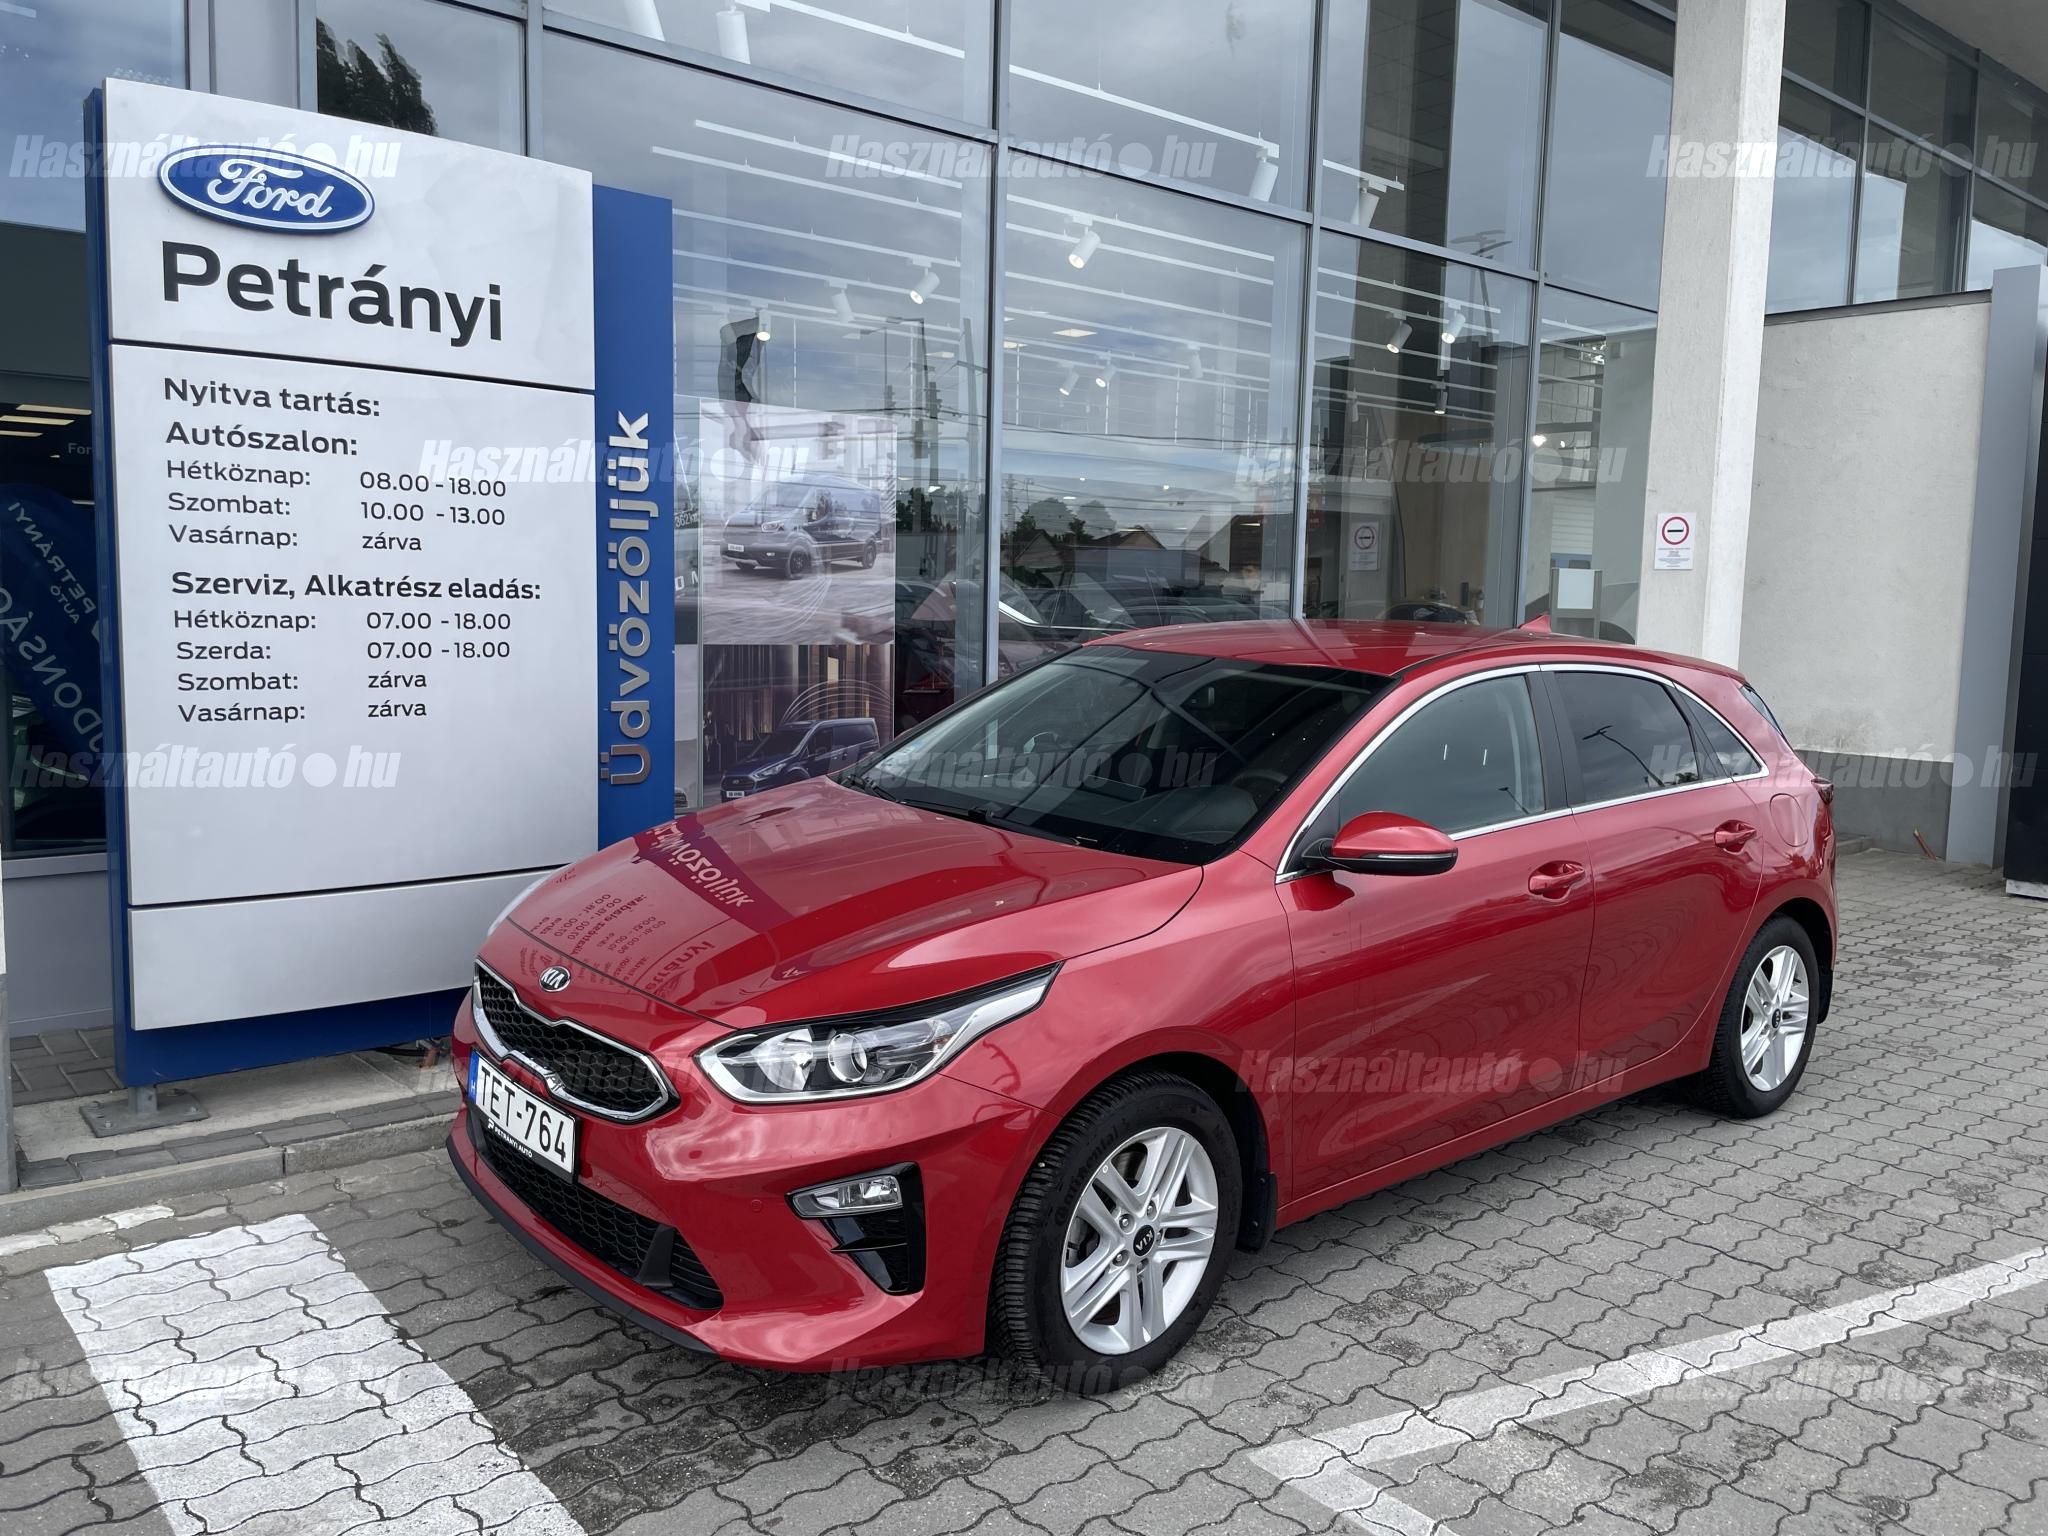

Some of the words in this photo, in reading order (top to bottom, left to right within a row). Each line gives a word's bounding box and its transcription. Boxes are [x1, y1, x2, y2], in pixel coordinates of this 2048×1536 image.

[162, 240, 502, 347] Petrányi
[165, 378, 271, 408] Nyitva
[279, 389, 379, 416] tartás:
[166, 422, 356, 455] Autószalon:
[168, 460, 310, 488] Hétköznap:
[361, 472, 429, 492] 08.00
[449, 478, 505, 497] 18.00
[169, 493, 289, 515] Szombat:
[361, 502, 423, 521] 10.00
[450, 507, 504, 525] 13.00
[169, 525, 297, 549] Vasárnap:
[363, 532, 421, 550] zárva
[172, 572, 294, 599] Szerviz,
[305, 574, 442, 597] Alkatrész
[449, 578, 540, 599] eladás:
[600, 411, 659, 787] Üdvözöljük
[175, 610, 315, 632] Hétköznap:
[367, 612, 431, 629] 07.00
[455, 613, 510, 629] 18.00
[177, 641, 270, 659] Szerda:
[368, 642, 431, 658] 07.00
[454, 642, 510, 658] 18.00
[178, 672, 297, 691] Szombat:
[368, 671, 427, 688] zárva
[178, 703, 304, 723] Vasárnap:
[368, 700, 427, 717] zárva
[481, 1065, 566, 1163] TET-764
